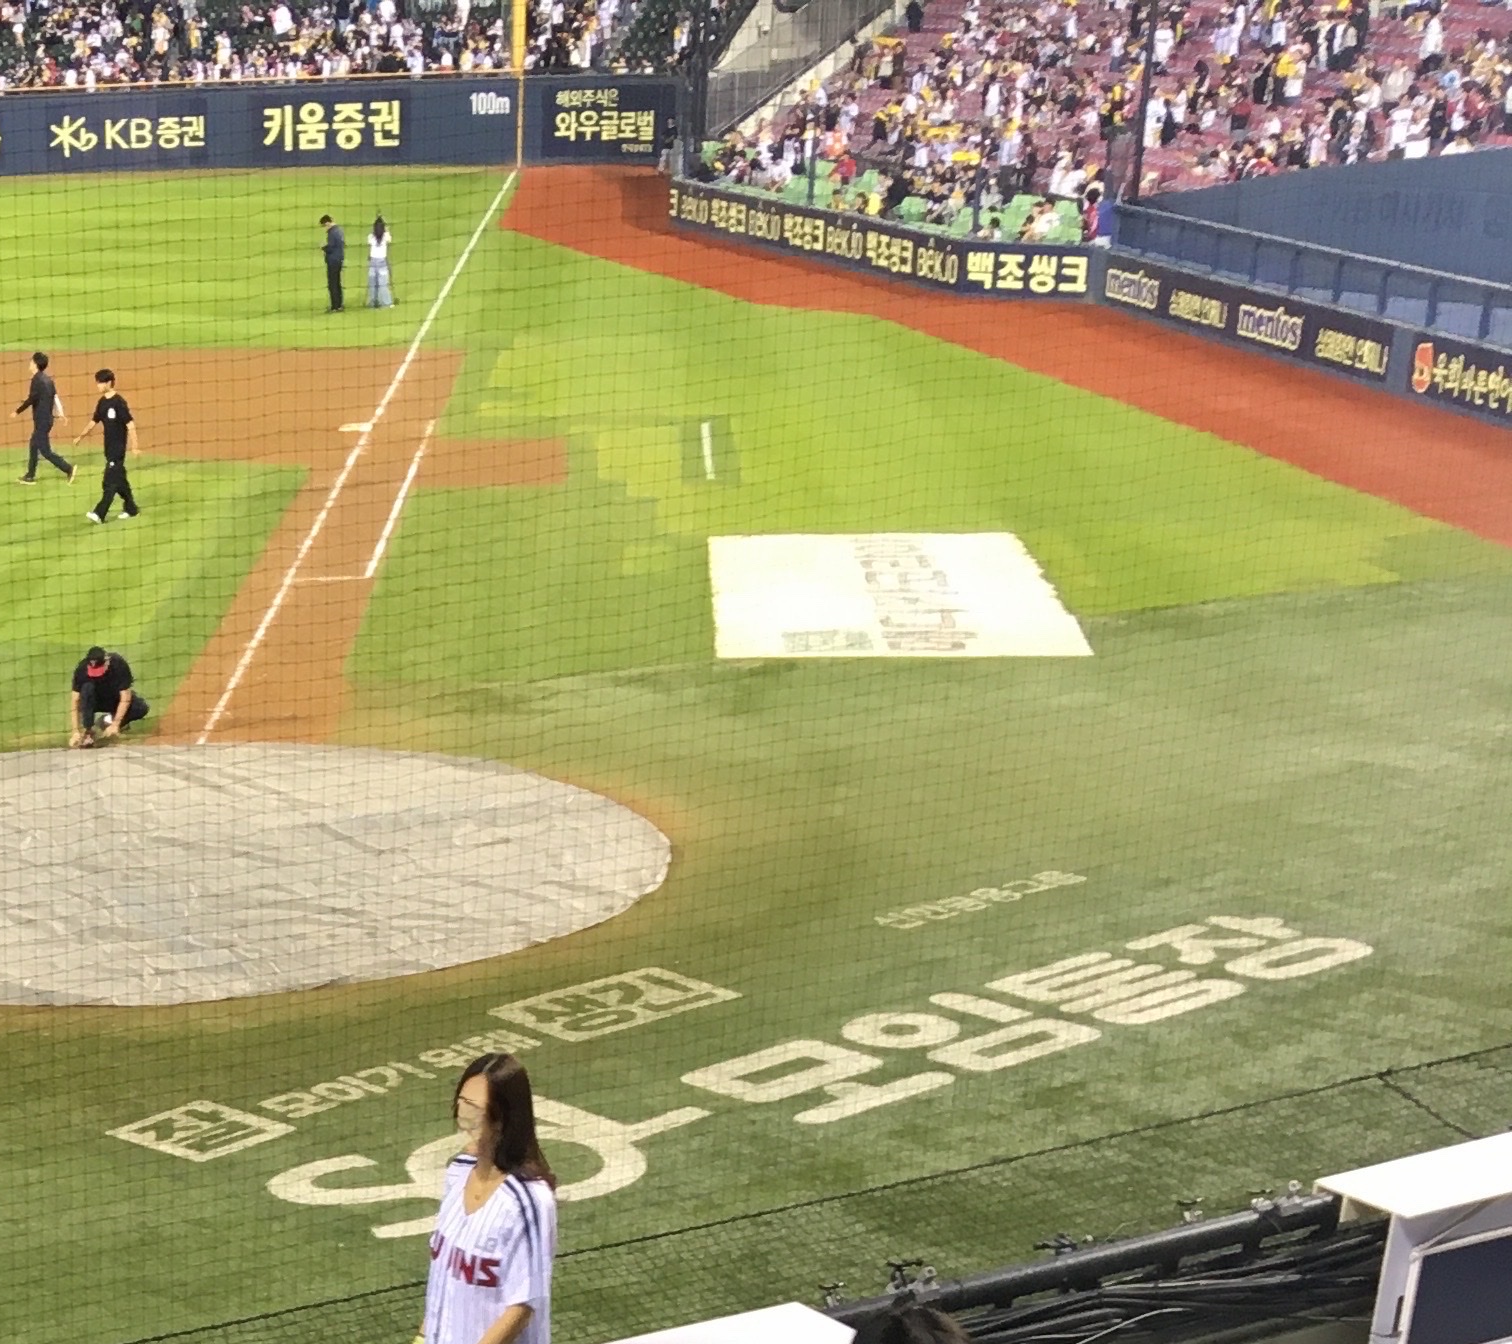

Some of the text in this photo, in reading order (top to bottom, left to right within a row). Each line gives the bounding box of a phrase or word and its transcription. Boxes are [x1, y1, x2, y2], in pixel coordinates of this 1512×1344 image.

[470, 92, 510, 115] 100m
[555, 88, 619, 107] 해외주식은
[262, 99, 401, 151] 키움증권
[553, 110, 655, 141] 와우글로벌
[966, 251, 1088, 293] 백조씽크
[1237, 303, 1305, 351] mentos
[681, 915, 1375, 1124] 모임통장
[257, 1061, 436, 1118] 모이기
